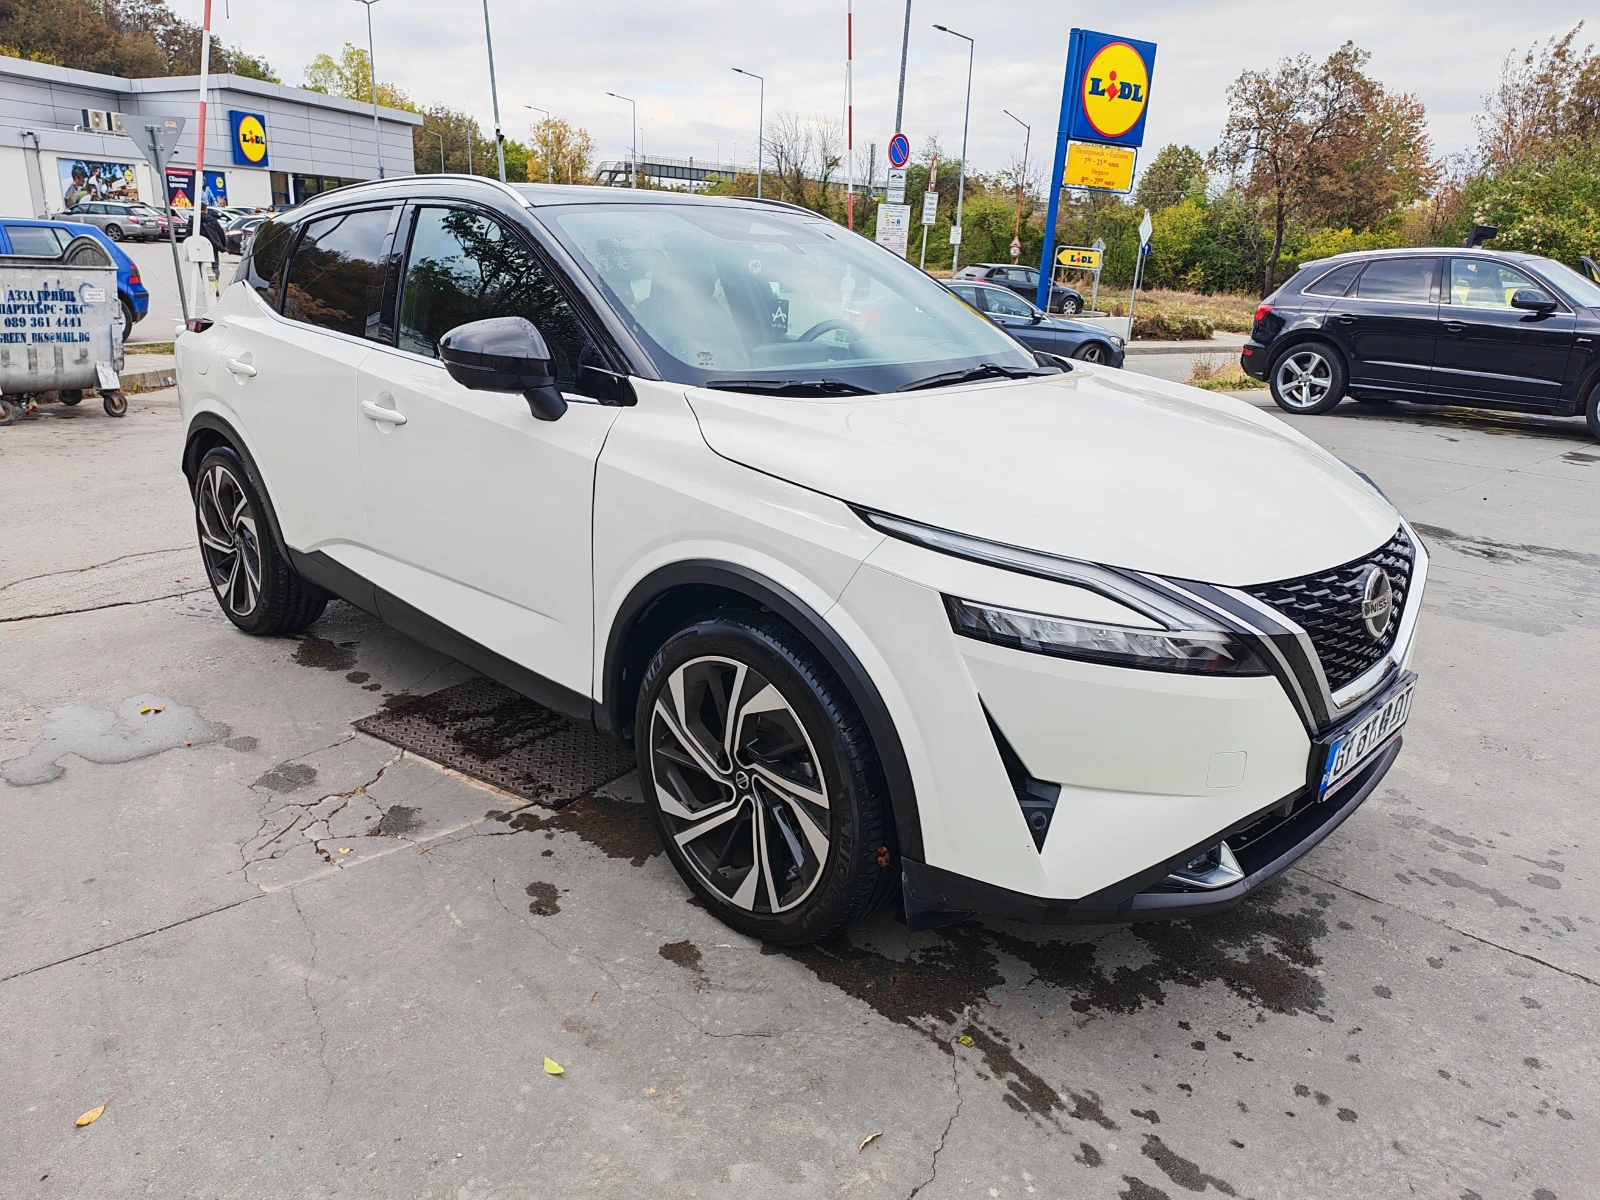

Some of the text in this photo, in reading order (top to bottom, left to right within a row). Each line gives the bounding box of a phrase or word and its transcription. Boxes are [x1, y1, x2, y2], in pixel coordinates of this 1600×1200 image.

[1088, 71, 1144, 102] LIDL
[241, 130, 265, 145] LIDL
[1070, 252, 1093, 264] LIDL
[65, 303, 86, 315] БКС
[4, 317, 82, 328] 089 361 4441
